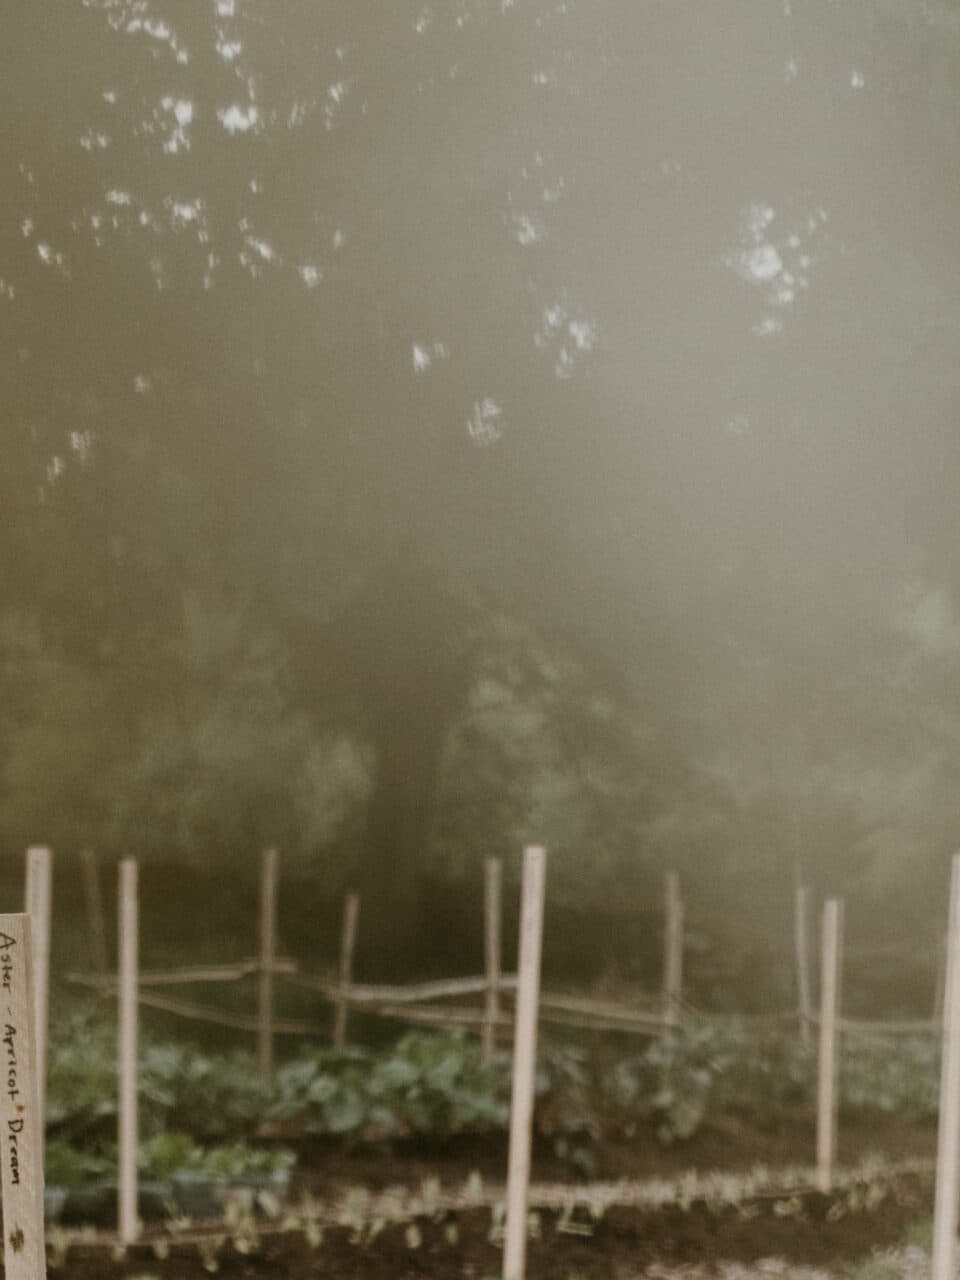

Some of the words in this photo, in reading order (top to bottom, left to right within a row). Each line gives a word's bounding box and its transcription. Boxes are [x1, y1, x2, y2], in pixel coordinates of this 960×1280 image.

[0, 932, 17, 994] Aster
[3, 1023, 20, 1101] Apricot
[8, 1118, 24, 1185] Dream
